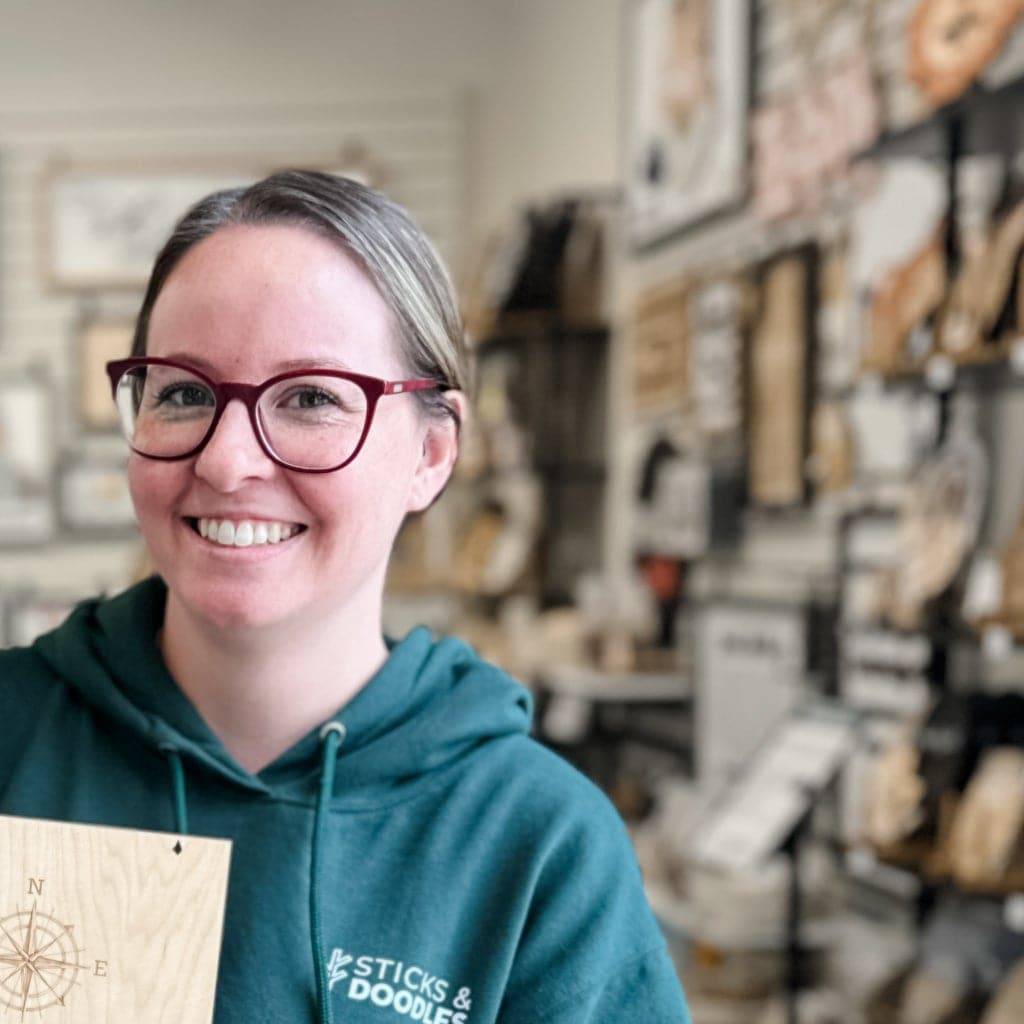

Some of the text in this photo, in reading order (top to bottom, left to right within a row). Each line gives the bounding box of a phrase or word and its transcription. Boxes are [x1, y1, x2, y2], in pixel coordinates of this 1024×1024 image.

[27, 878, 45, 896] N
[92, 959, 109, 977] E
[353, 955, 472, 1011] STICKS &
